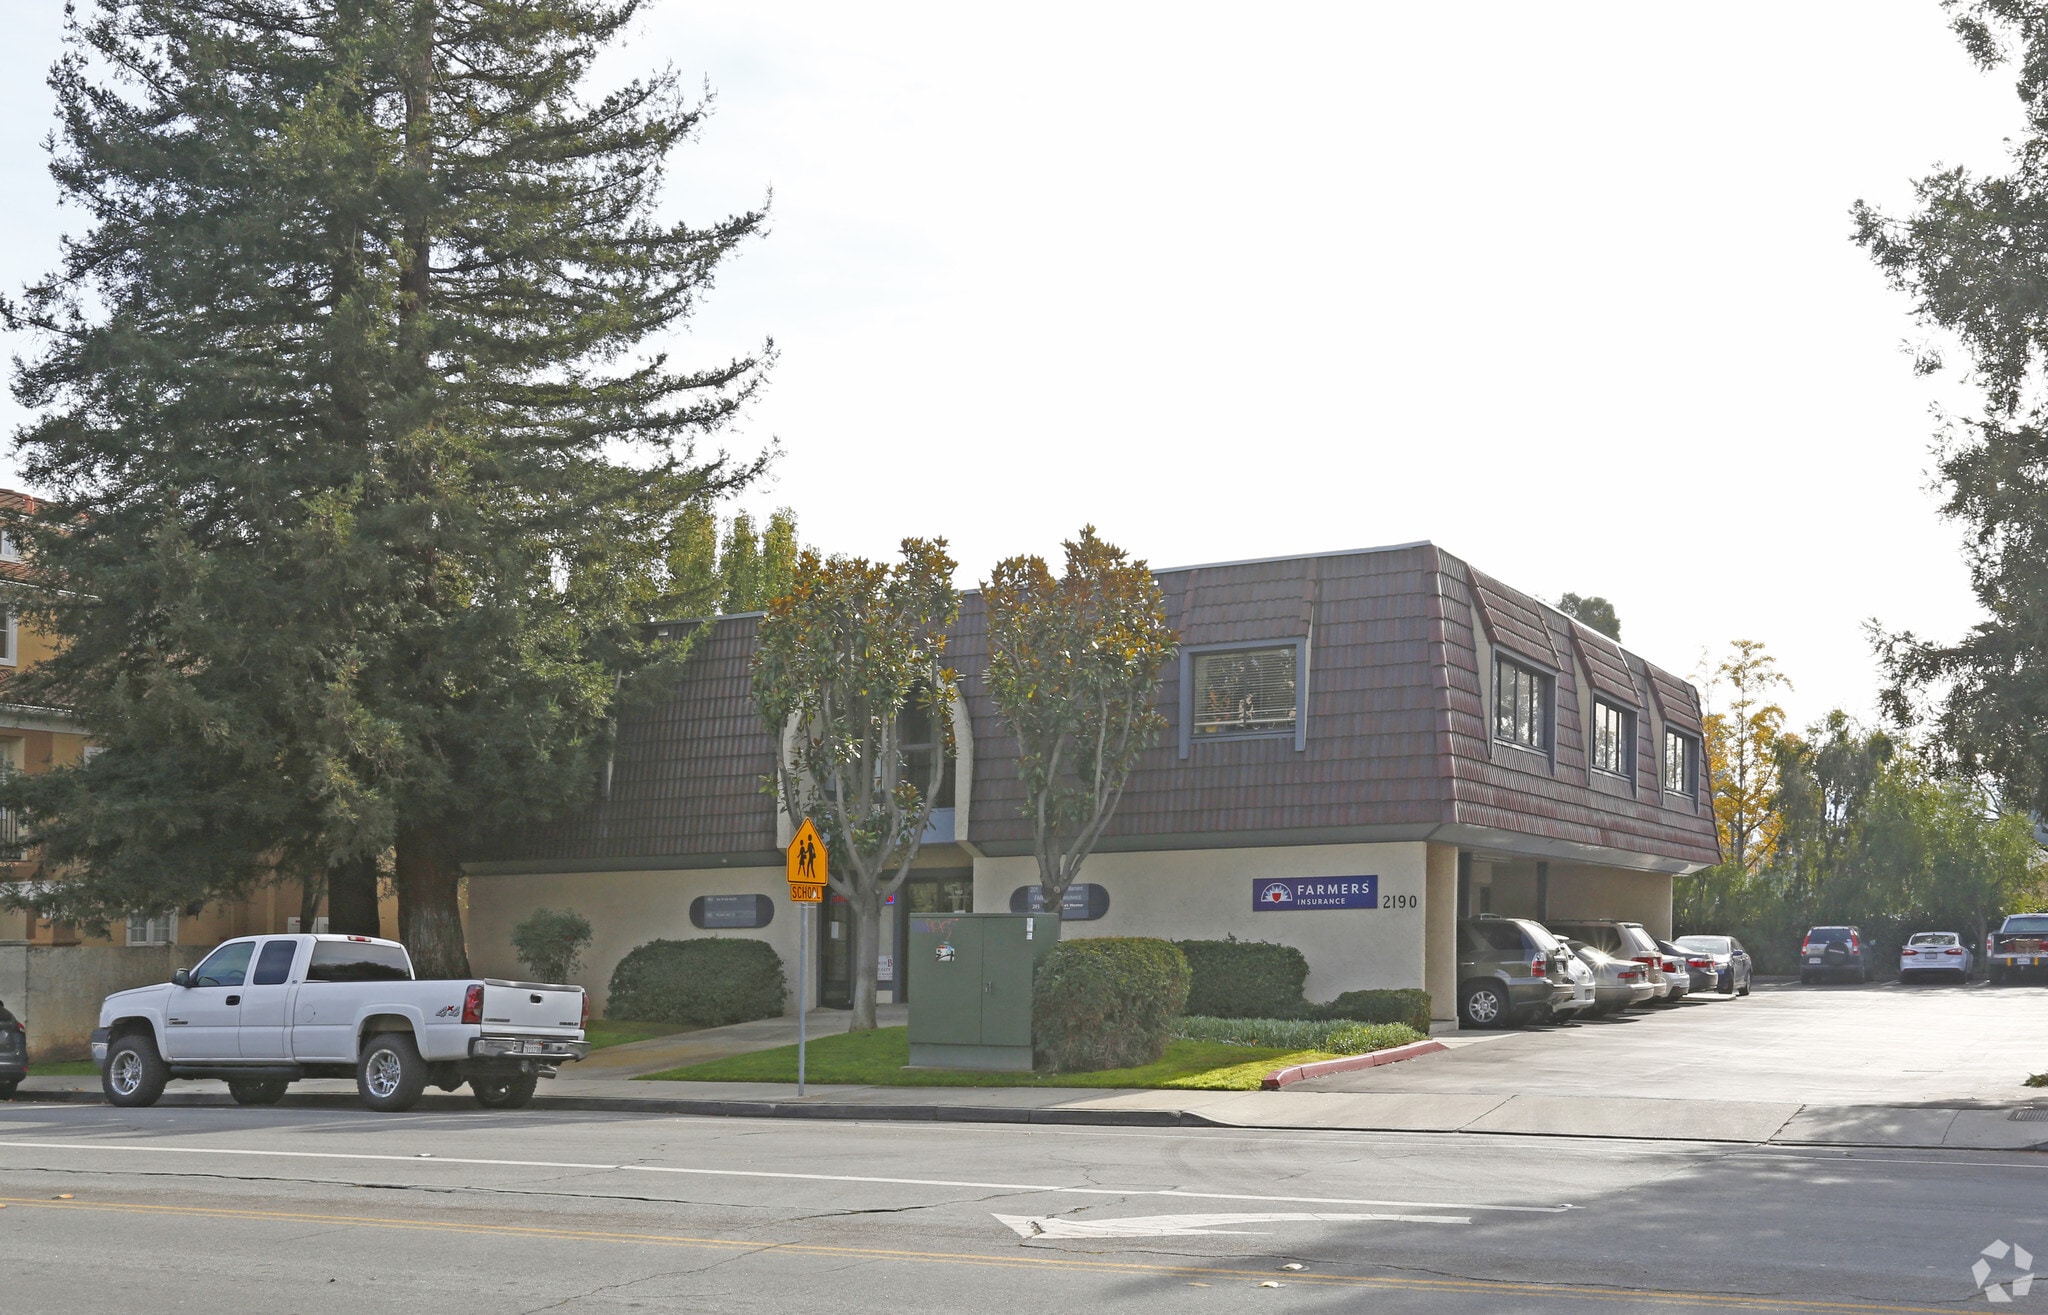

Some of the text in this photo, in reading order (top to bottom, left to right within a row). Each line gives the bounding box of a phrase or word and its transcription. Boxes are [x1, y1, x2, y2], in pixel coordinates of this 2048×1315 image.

[792, 886, 821, 900] SCHOOL
[1297, 883, 1370, 895] FARMERS
[1297, 898, 1346, 906] INSURANCE
[1383, 895, 1417, 909] 2190
